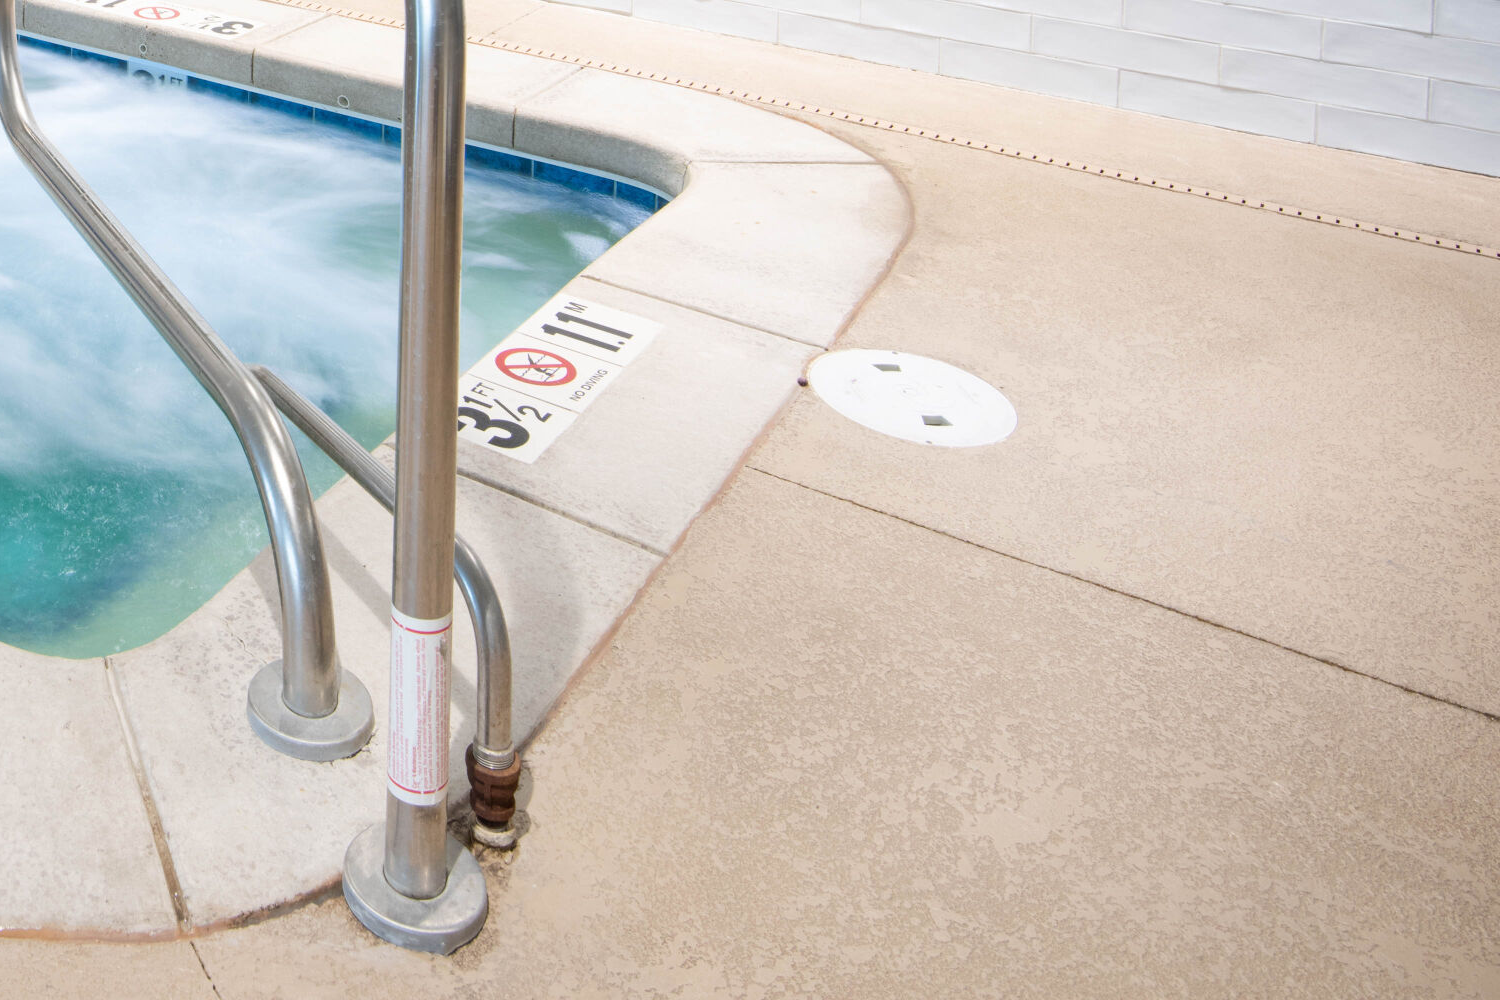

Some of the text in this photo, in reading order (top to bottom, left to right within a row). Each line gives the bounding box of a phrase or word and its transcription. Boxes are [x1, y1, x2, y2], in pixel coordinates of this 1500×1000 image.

[211, 21, 255, 35] 3
[541, 301, 634, 353] 1.1 M
[471, 382, 495, 398] FT
[569, 369, 609, 402] NO DIVING
